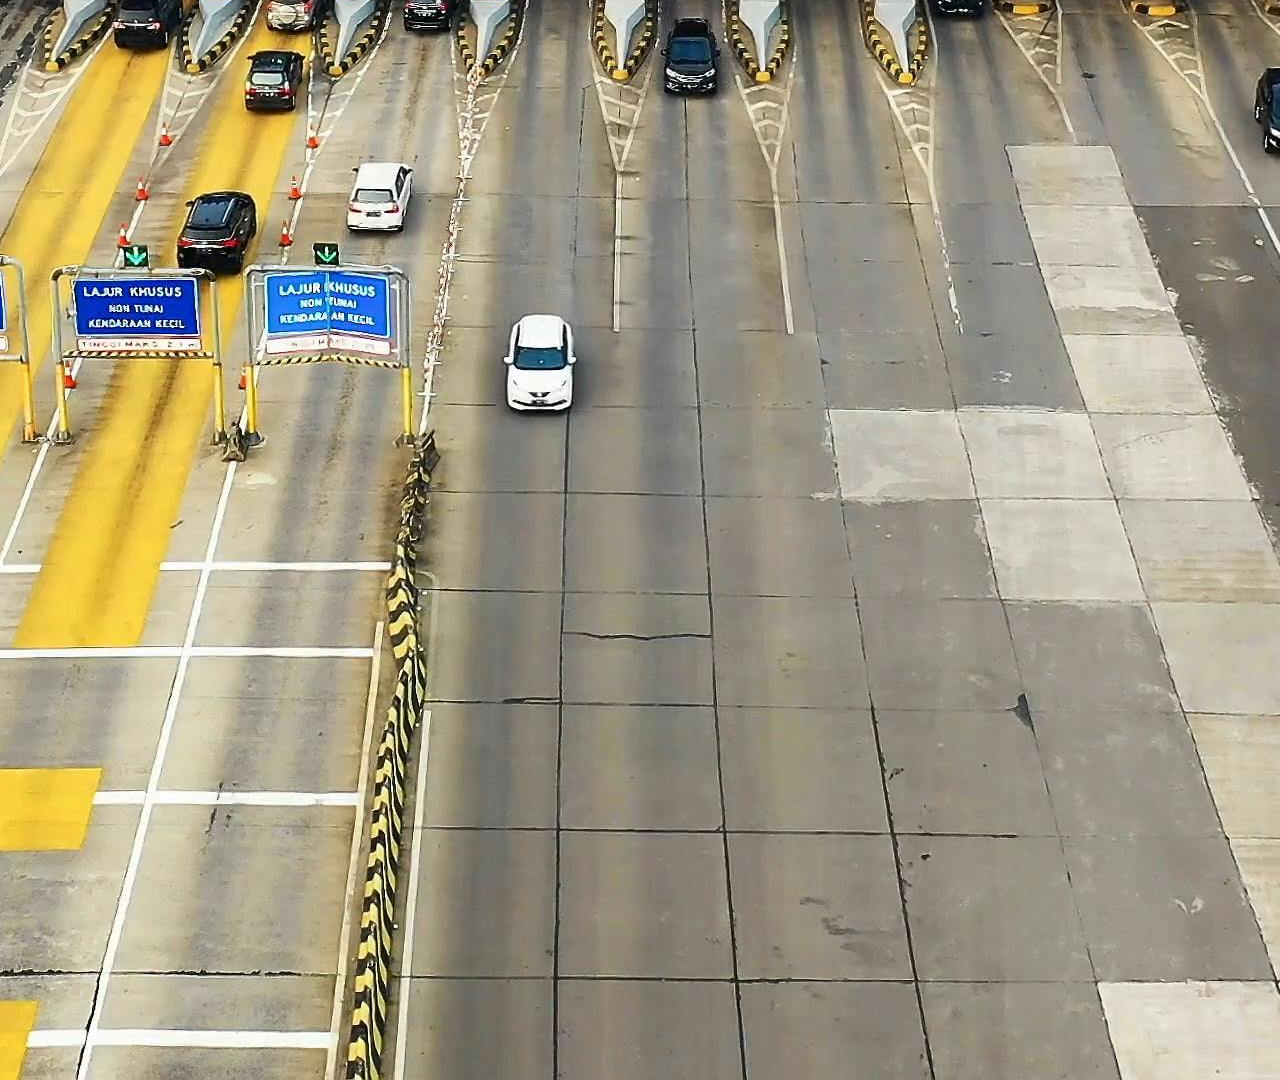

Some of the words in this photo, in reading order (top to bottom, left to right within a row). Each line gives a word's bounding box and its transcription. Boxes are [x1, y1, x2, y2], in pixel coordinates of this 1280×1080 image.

[83, 287, 123, 297] LAJUR
[130, 286, 182, 297] KHUSUS
[279, 283, 321, 296] LAJUR
[300, 298, 322, 308] NON
[108, 304, 130, 313] NON
[134, 304, 164, 313] TUNAI
[88, 319, 151, 328] KENDARAAN
[155, 319, 185, 329] KECIL
